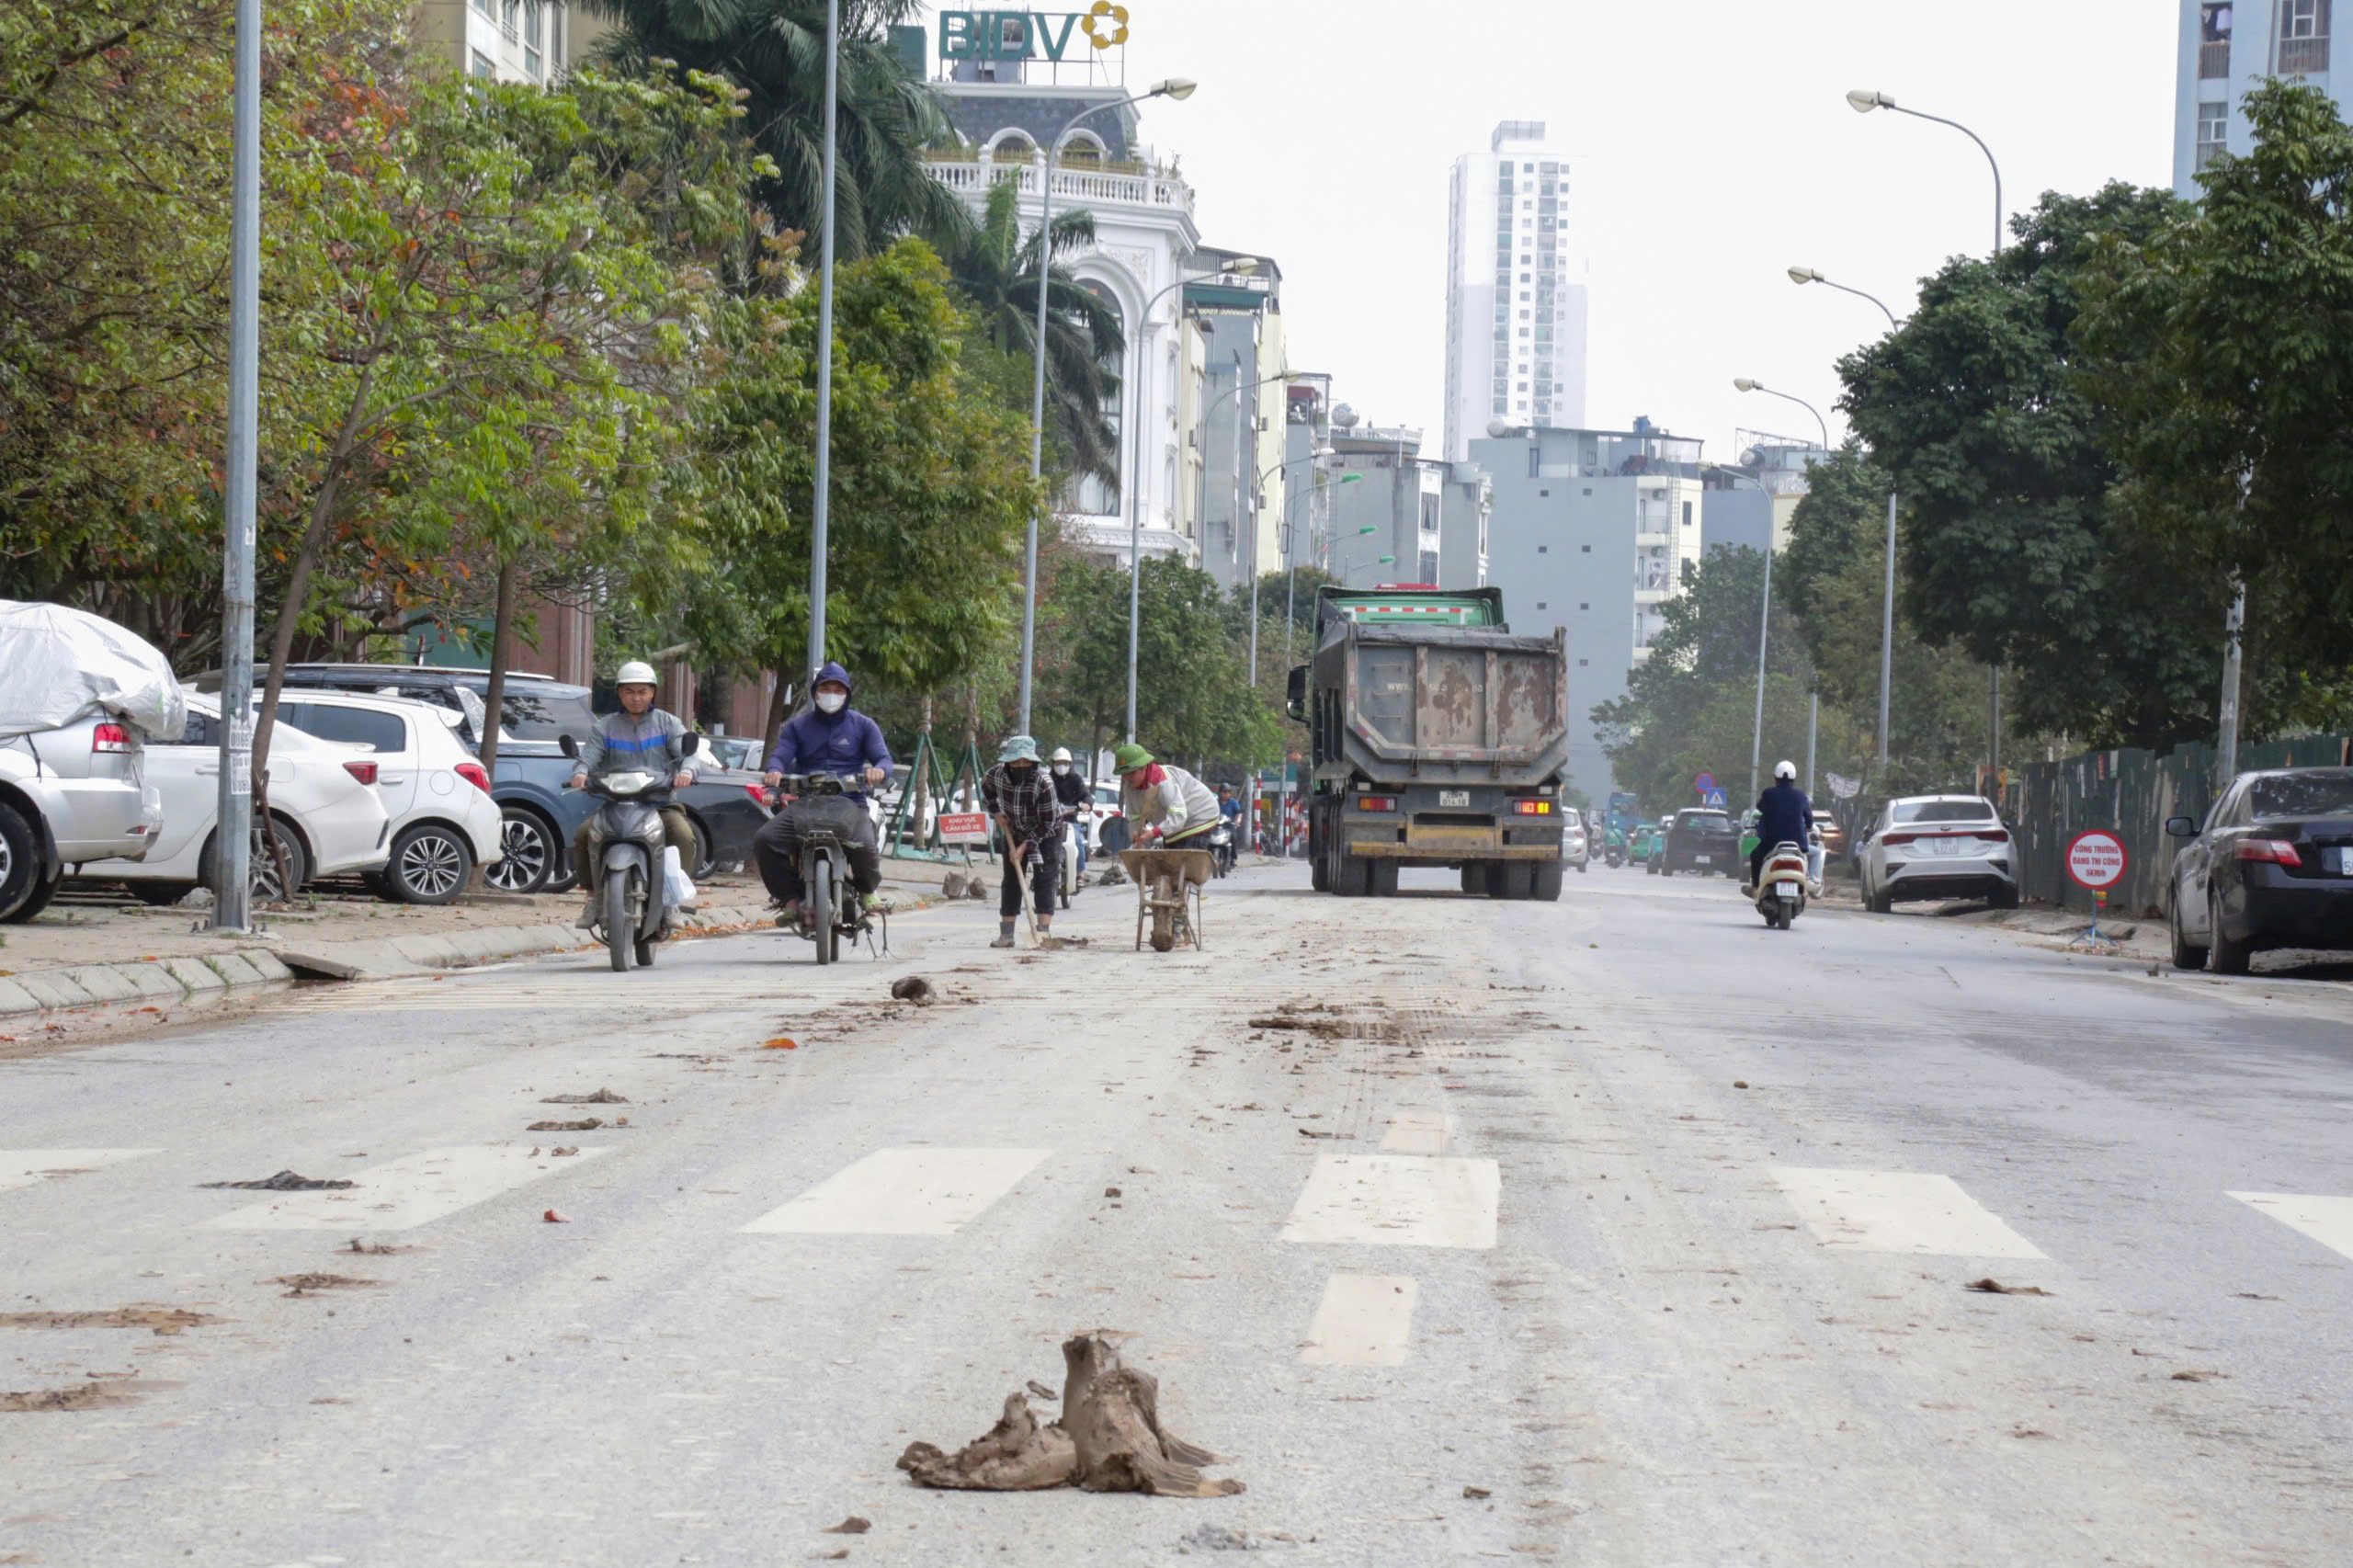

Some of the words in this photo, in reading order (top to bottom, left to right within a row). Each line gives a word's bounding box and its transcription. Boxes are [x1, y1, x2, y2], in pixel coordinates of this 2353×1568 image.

[939, 10, 1081, 62] BIDV
[2075, 844, 2093, 853] CÔNG
[2102, 857, 2120, 866] CÔNG
